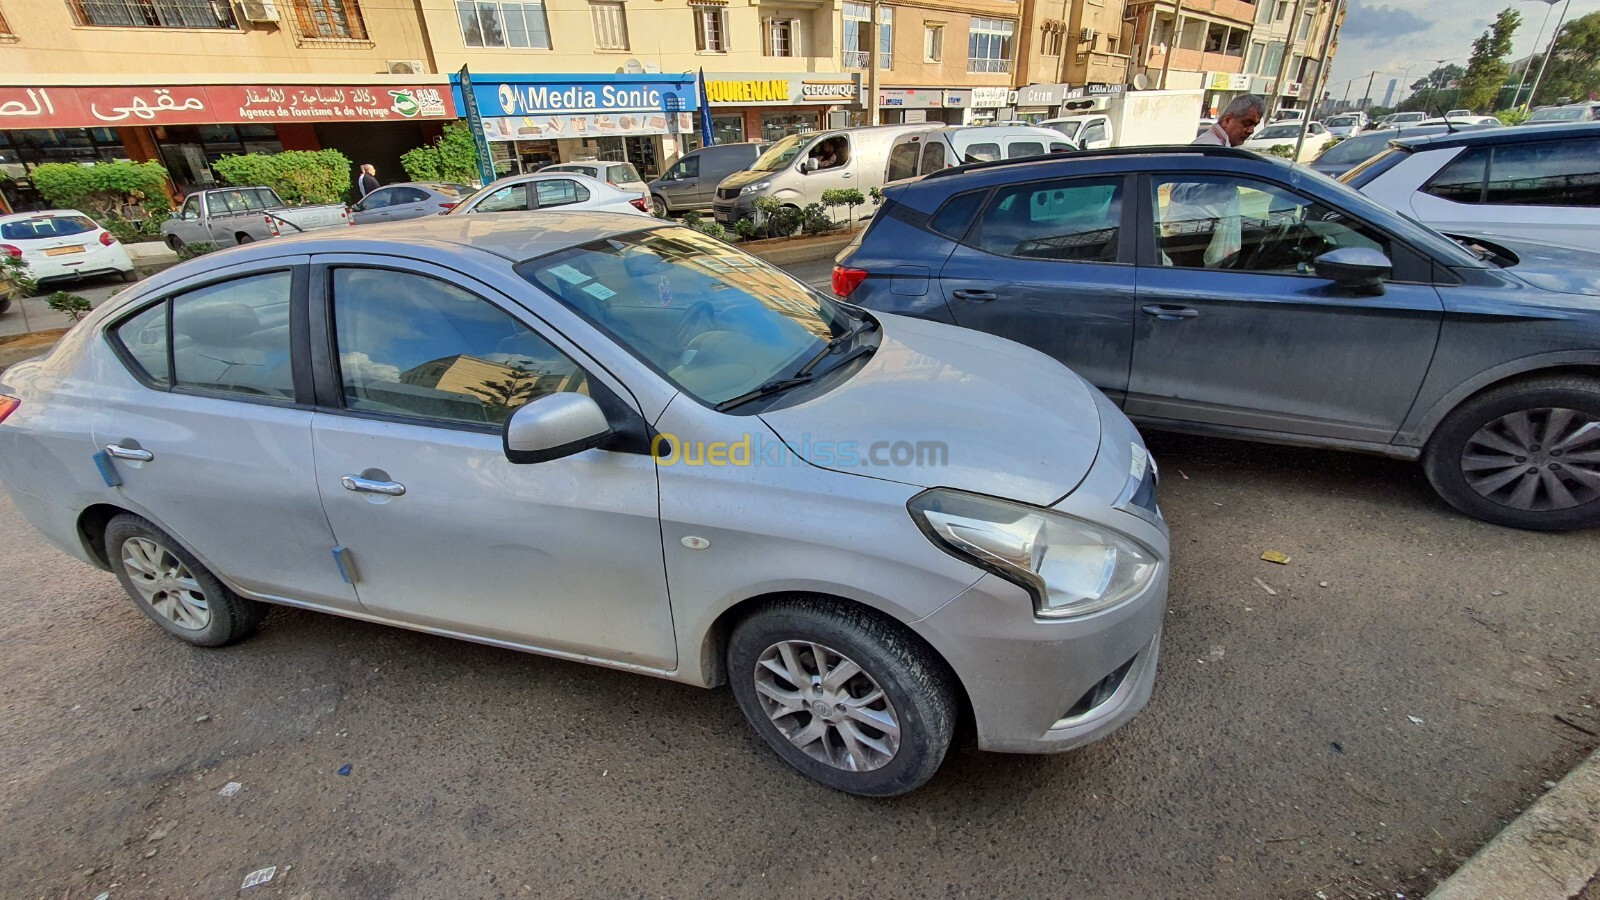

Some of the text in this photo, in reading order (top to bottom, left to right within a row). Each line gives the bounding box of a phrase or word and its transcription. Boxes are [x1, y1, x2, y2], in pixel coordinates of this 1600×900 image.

[300, 87, 345, 105] السياحة
[350, 88, 377, 106] وكالة
[528, 85, 660, 109] Media Sonic
[705, 79, 789, 102] BOURENANE
[803, 84, 857, 97] CERAMIQUE
[1028, 90, 1053, 102] Ceram
[91, 88, 204, 122] مقهى
[291, 94, 298, 107] و
[239, 105, 389, 120] Agence de Tourisme & de Voyage
